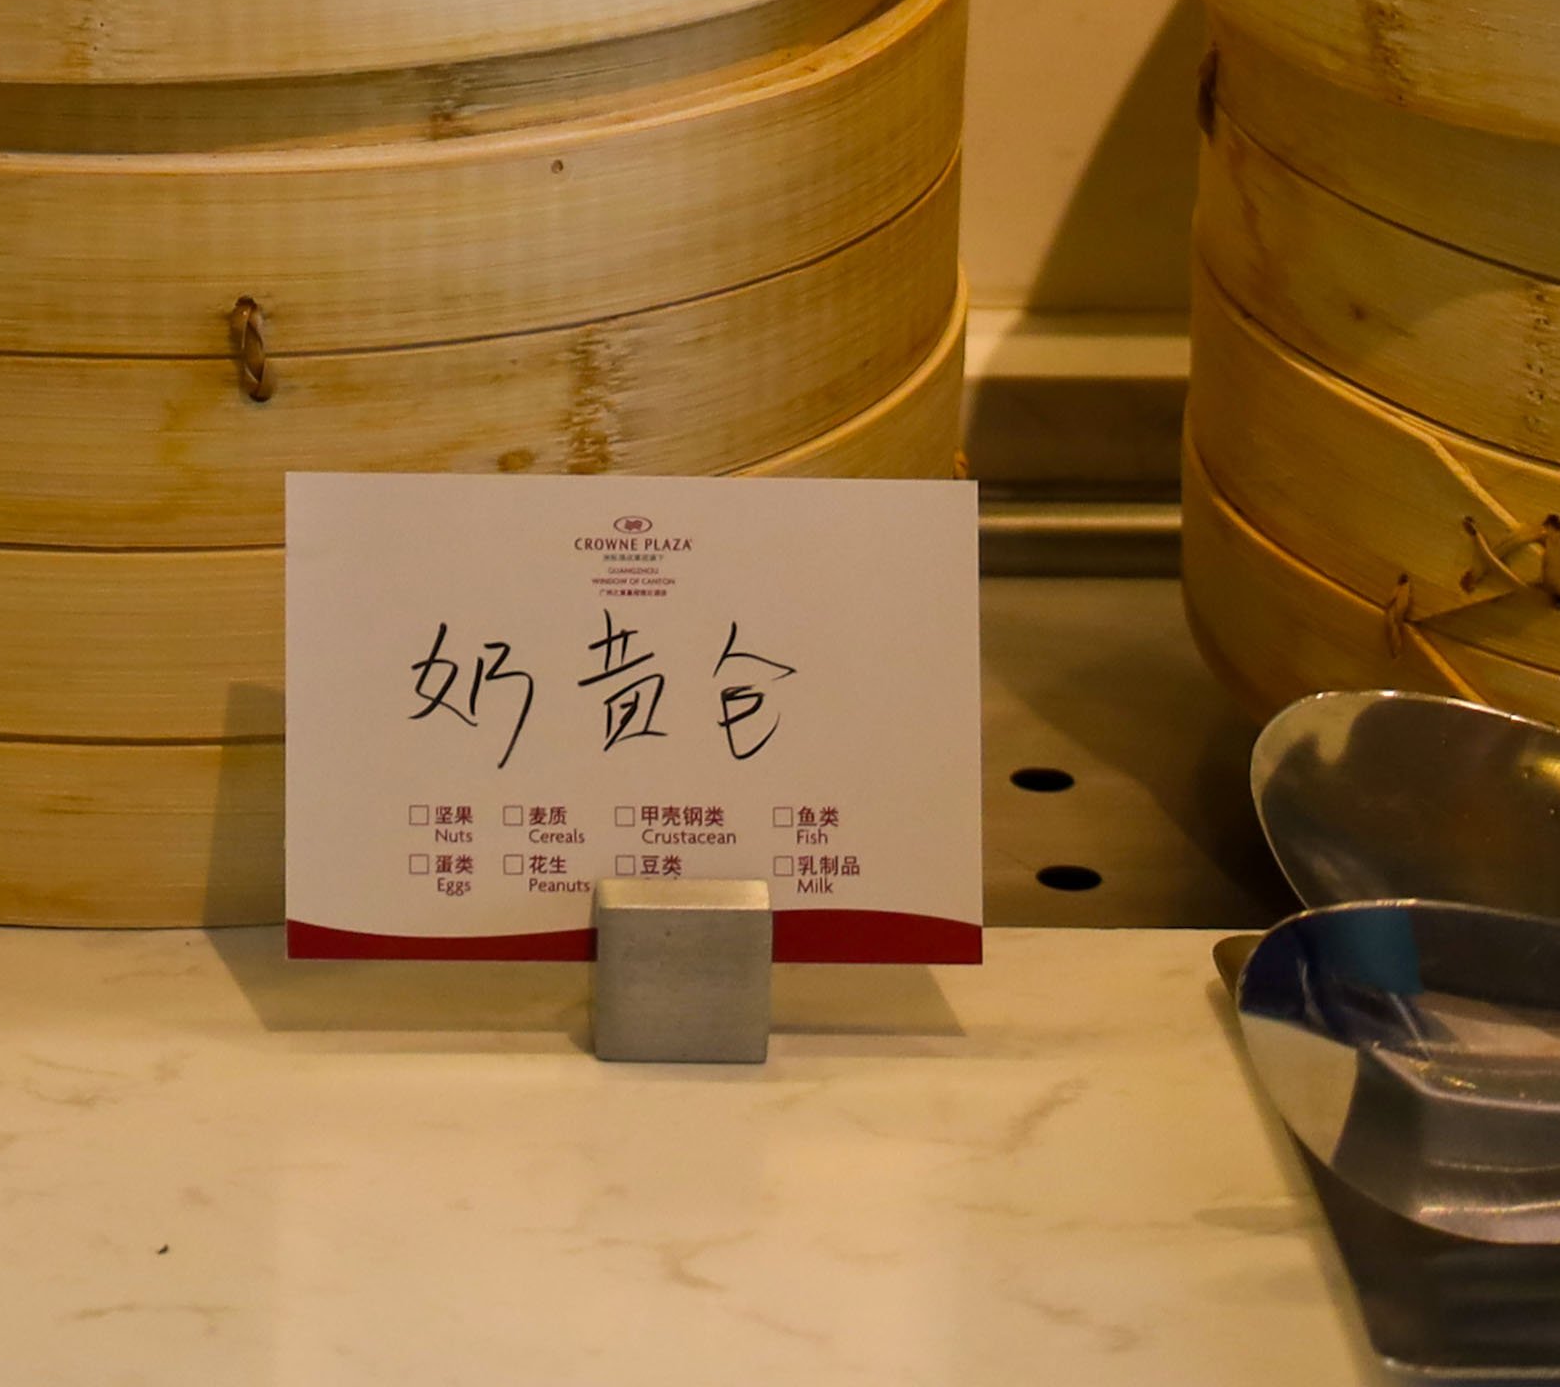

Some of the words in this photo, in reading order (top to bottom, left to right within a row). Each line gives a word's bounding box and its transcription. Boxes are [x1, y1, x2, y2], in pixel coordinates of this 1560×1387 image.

[574, 537, 638, 551] CROWNE
[644, 538, 690, 551] PLAZA
[641, 578, 676, 586] CANTON
[406, 609, 798, 769] 奶黄包
[435, 806, 473, 825] 坚果
[529, 806, 568, 825] 麦质
[798, 806, 839, 827] 鱼类
[435, 830, 473, 843] Nuts
[529, 829, 585, 844] Cereals
[642, 829, 736, 845] Crustacean
[797, 829, 829, 845] Fish
[435, 855, 473, 874] 蛋类
[529, 855, 567, 874] 花生
[641, 855, 682, 876] 豆类
[798, 856, 860, 876] 乳制品
[437, 878, 472, 896] Eggs
[529, 878, 591, 893] Peanuts
[797, 878, 833, 894] Milk
